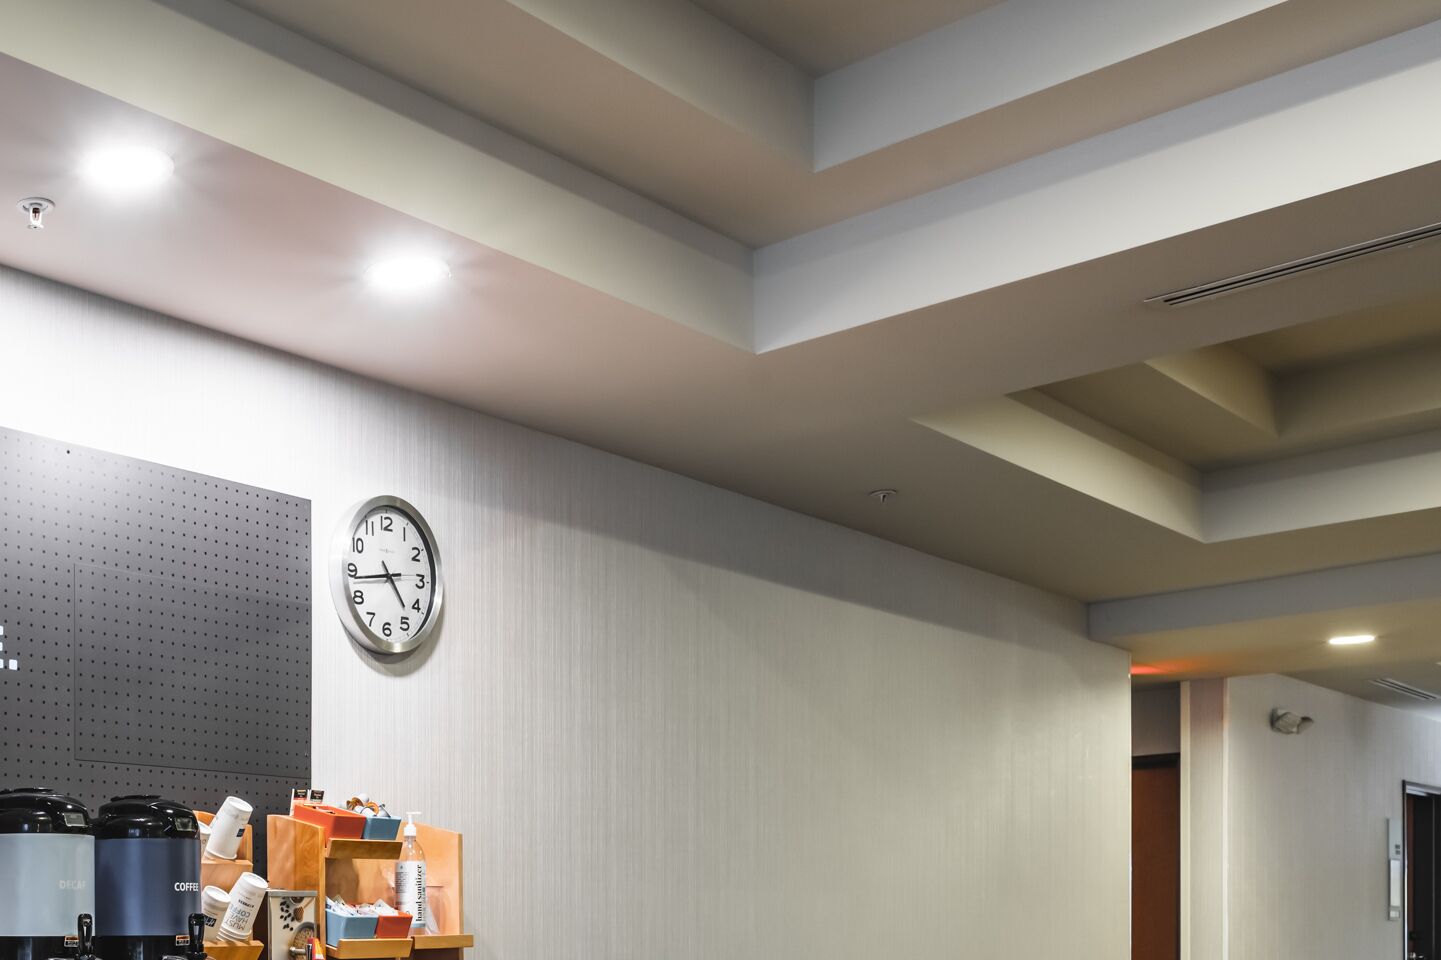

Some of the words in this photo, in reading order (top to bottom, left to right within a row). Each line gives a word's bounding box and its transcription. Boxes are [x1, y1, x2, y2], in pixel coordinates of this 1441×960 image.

[365, 519, 375, 537] 11
[380, 515, 393, 532] 12
[352, 537, 364, 553] 10
[411, 547, 421, 562] 2
[347, 562, 358, 578] 9
[415, 574, 425, 589] 3
[352, 590, 365, 605] 8
[411, 598, 421, 613] 4
[366, 611, 376, 627] 7
[399, 616, 410, 631] 5
[382, 622, 392, 637] 6
[174, 882, 199, 892] COFFEE
[225, 919, 246, 931] MUST
[229, 913, 249, 924] HAVE
